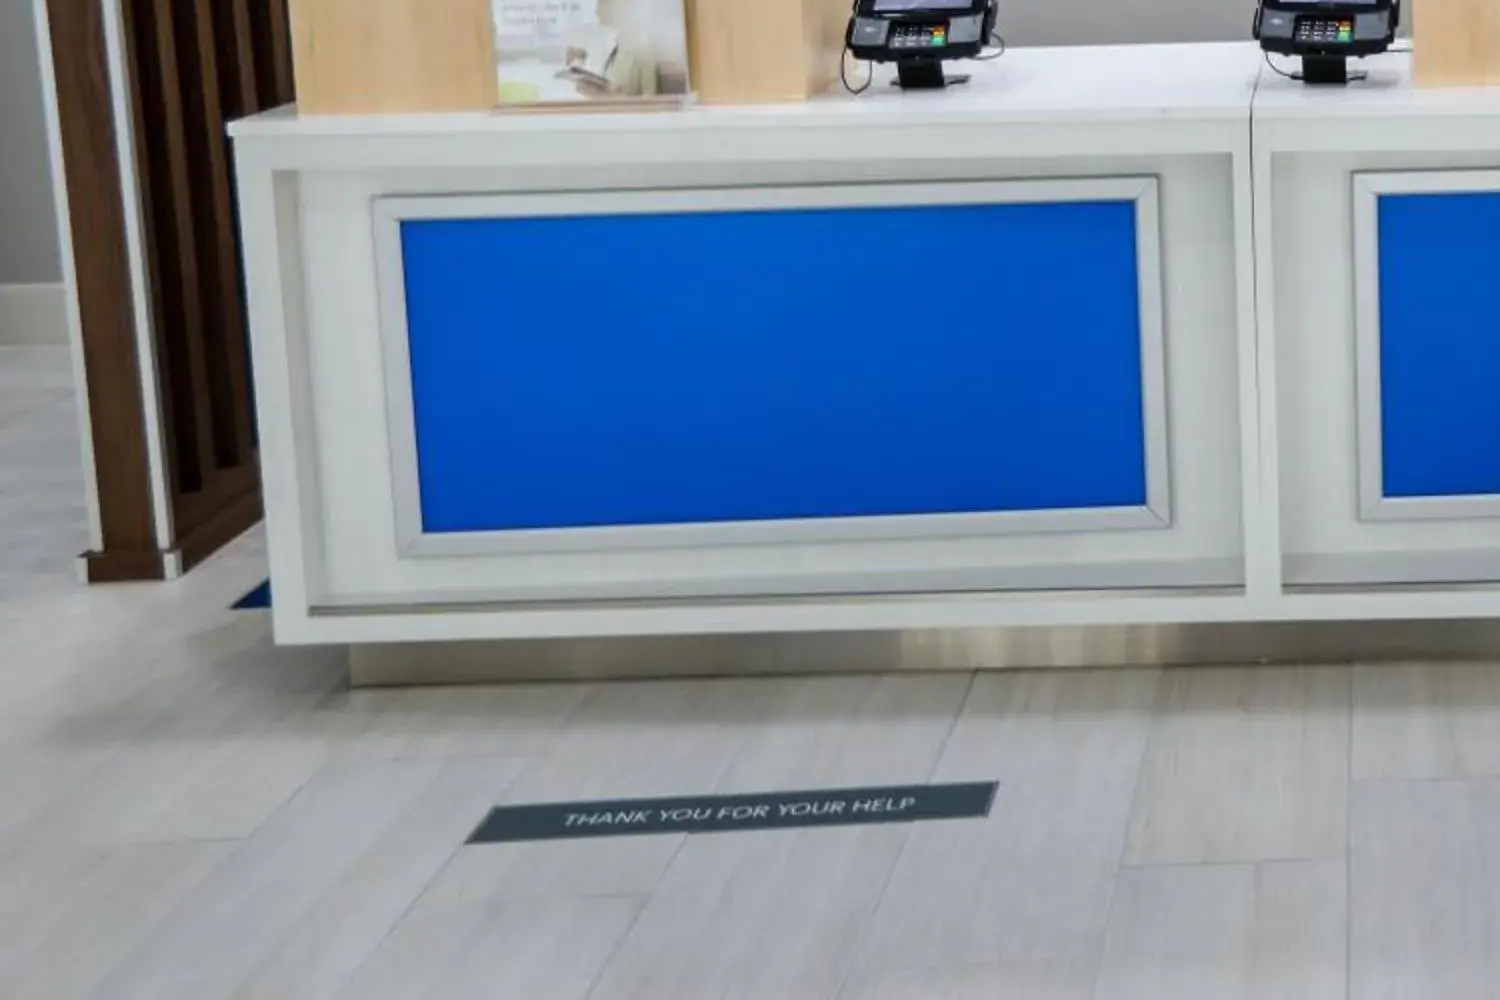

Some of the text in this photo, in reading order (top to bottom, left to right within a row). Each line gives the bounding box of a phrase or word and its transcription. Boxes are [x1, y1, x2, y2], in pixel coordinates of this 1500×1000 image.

[563, 796, 917, 828] THANK YOU FOR YOUR HELP
